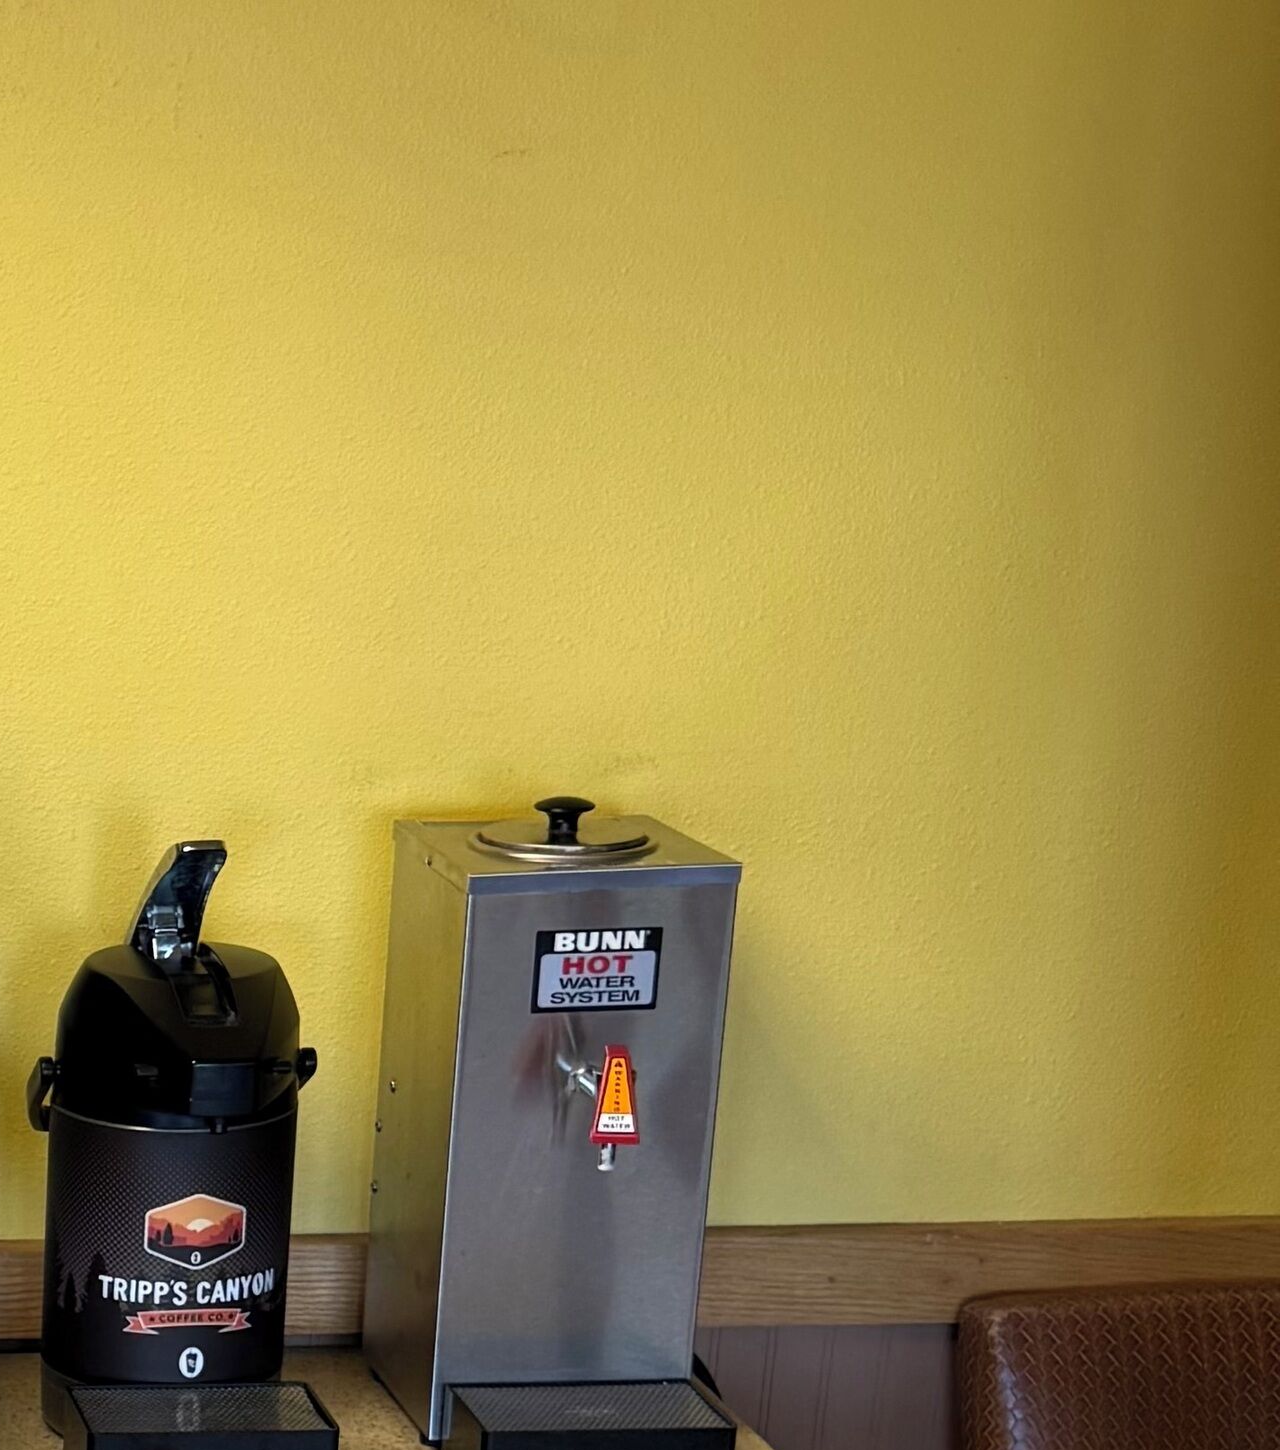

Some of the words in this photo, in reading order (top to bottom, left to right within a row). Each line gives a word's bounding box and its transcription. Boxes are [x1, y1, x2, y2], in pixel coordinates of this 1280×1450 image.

[553, 931, 646, 952] BUNN
[561, 955, 634, 975] HOT
[558, 975, 636, 990] WATER
[550, 990, 640, 1005] SYSTEM
[98, 1274, 188, 1306] TRIPP'S
[196, 1268, 275, 1304] CANYON
[159, 1313, 203, 1324] COFFEE
